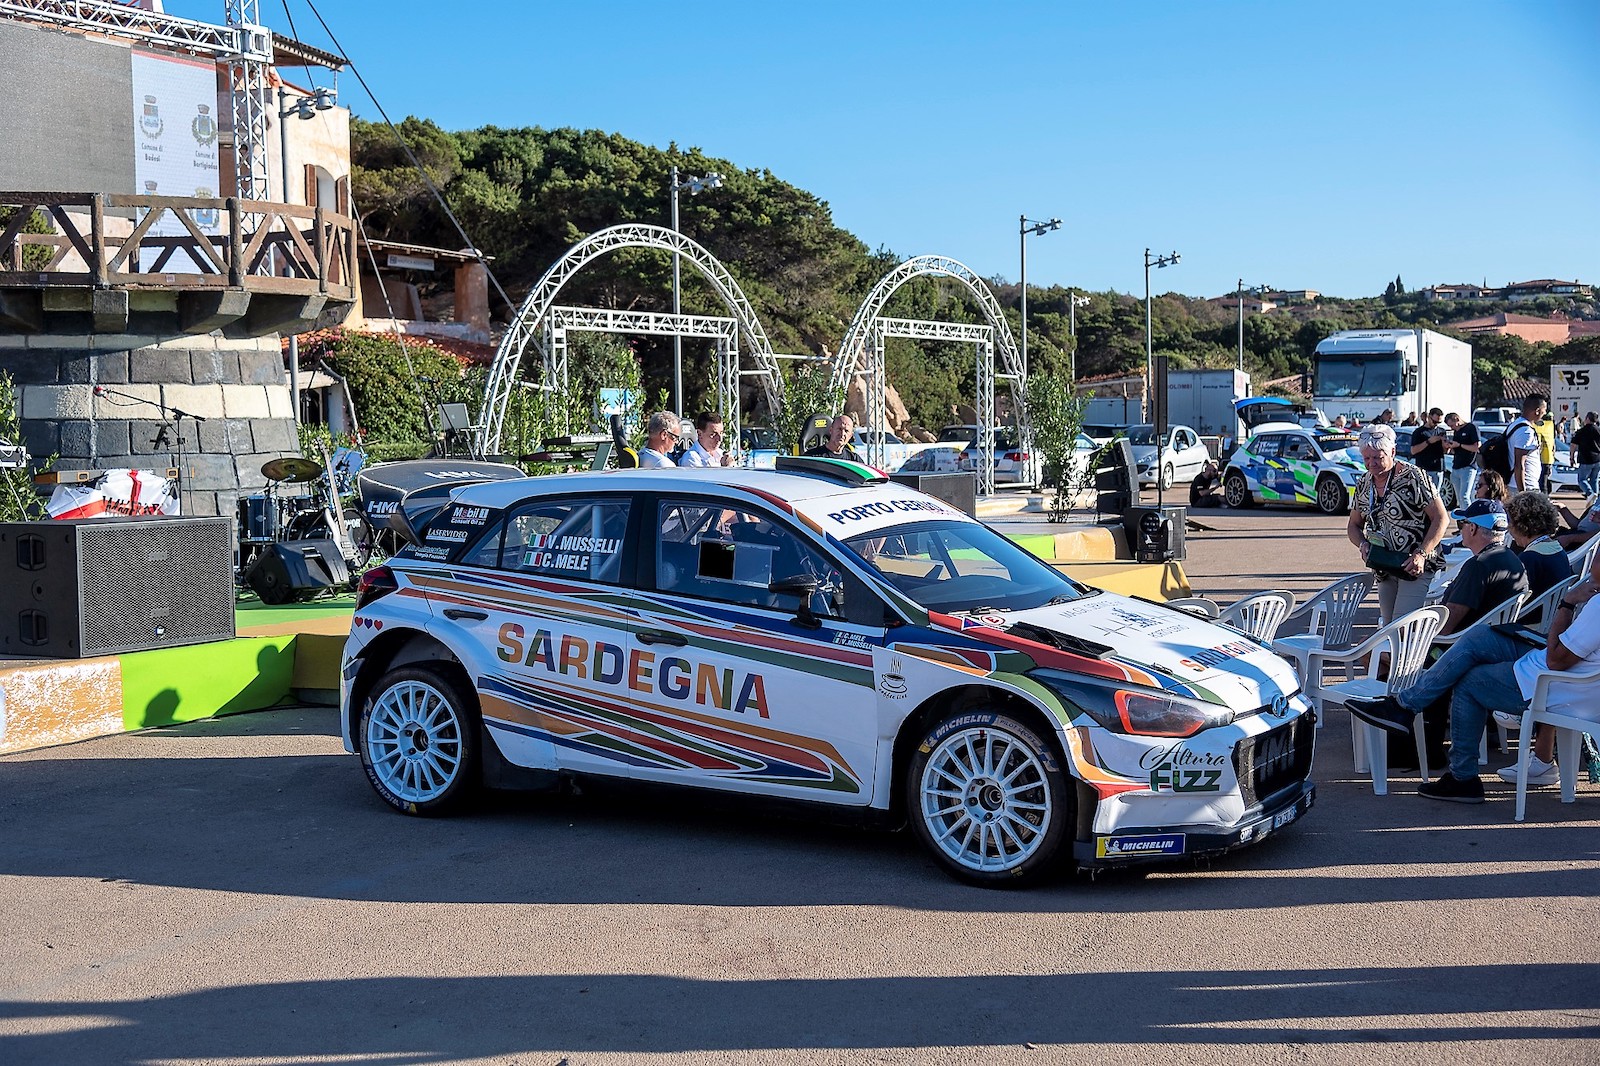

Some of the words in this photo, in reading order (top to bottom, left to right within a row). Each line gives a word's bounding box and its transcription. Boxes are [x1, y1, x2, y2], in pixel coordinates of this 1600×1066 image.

[141, 142, 157, 151] Comune
[195, 150, 210, 159] Comune
[1562, 370, 1590, 386] RS
[367, 500, 400, 514] HMI
[452, 506, 480, 519] Mobil
[827, 502, 894, 525] PORTO
[427, 527, 468, 539] LASERVIDEO
[541, 551, 590, 571] C.MELE
[841, 638, 873, 649] V.MUSSELL
[1179, 640, 1261, 672] SARDEGNA
[497, 622, 770, 719] SARDEGNA
[935, 714, 992, 739] MICHELIN
[1138, 740, 1226, 770] Altura
[1122, 840, 1175, 851] MICHELIN
